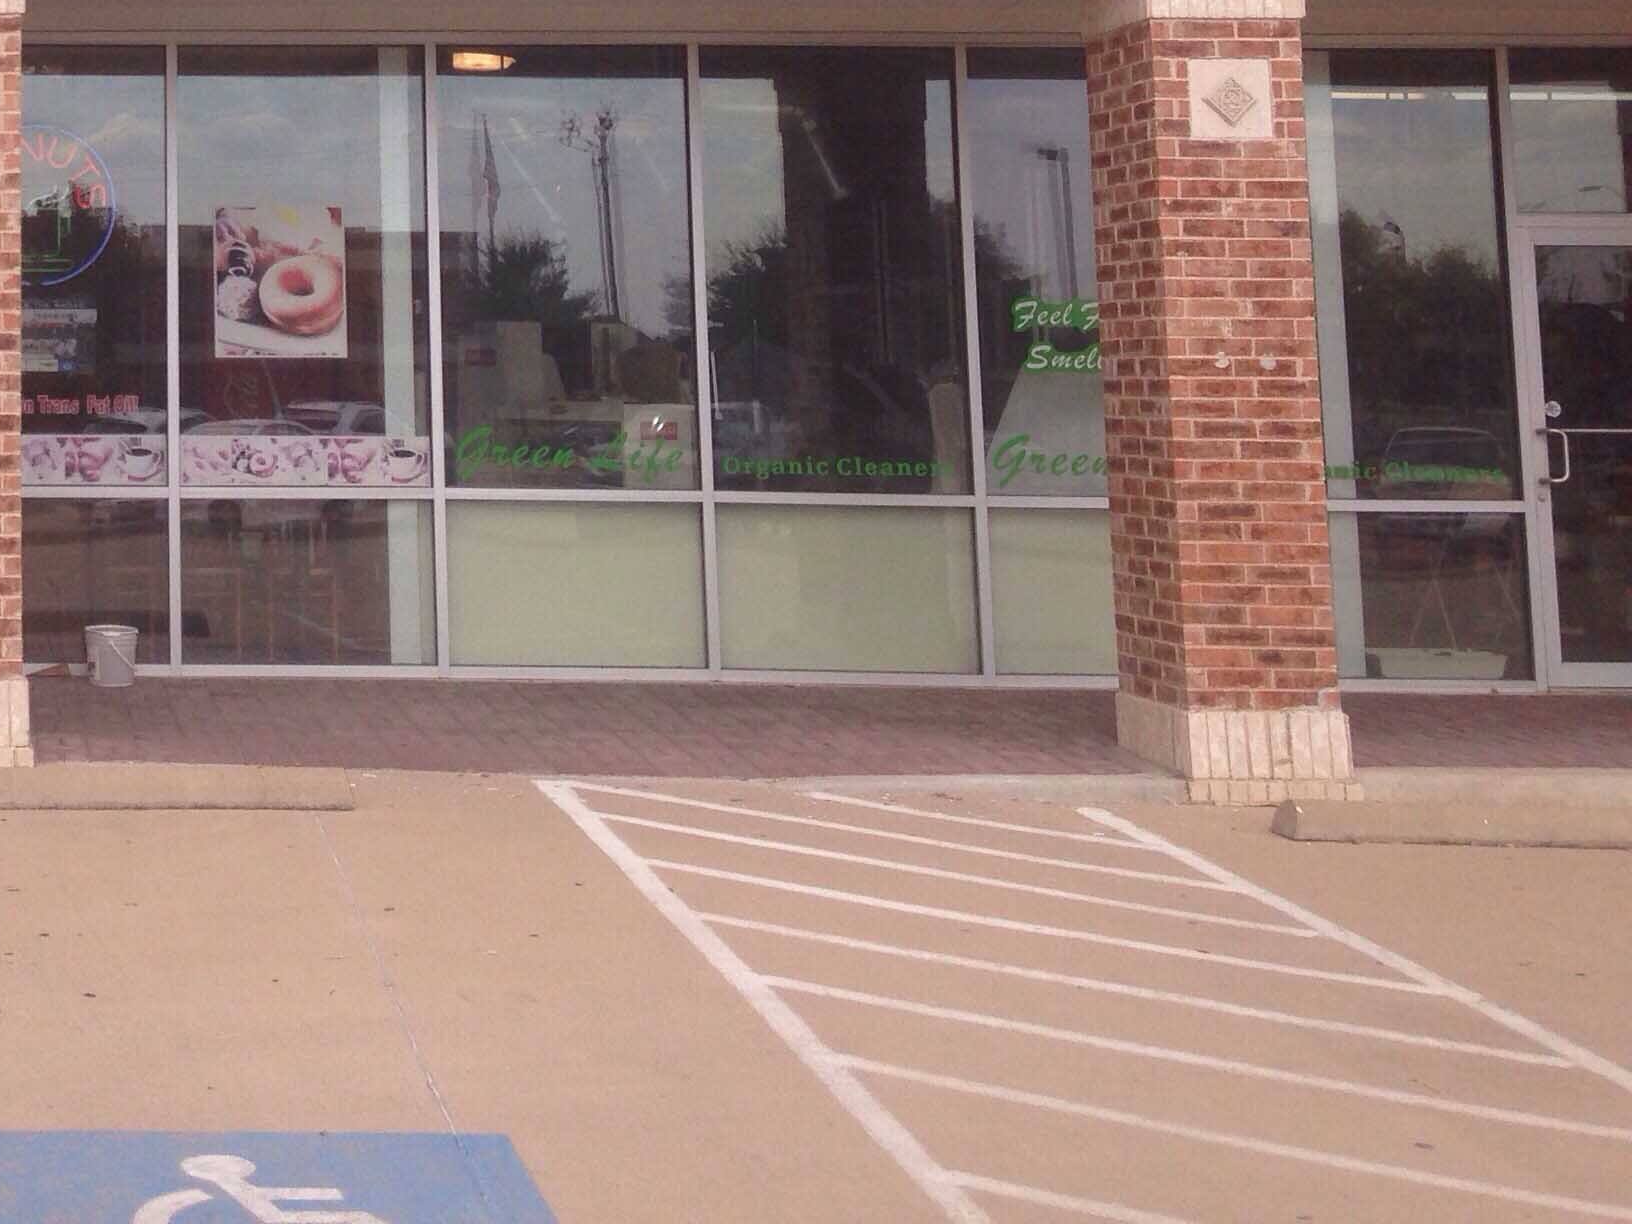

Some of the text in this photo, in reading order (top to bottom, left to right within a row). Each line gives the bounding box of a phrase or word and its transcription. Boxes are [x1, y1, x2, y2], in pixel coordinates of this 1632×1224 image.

[1014, 300, 1073, 330] Feel
[36, 393, 80, 415] Trans
[454, 422, 955, 484] Green Life Organic Cleaners
